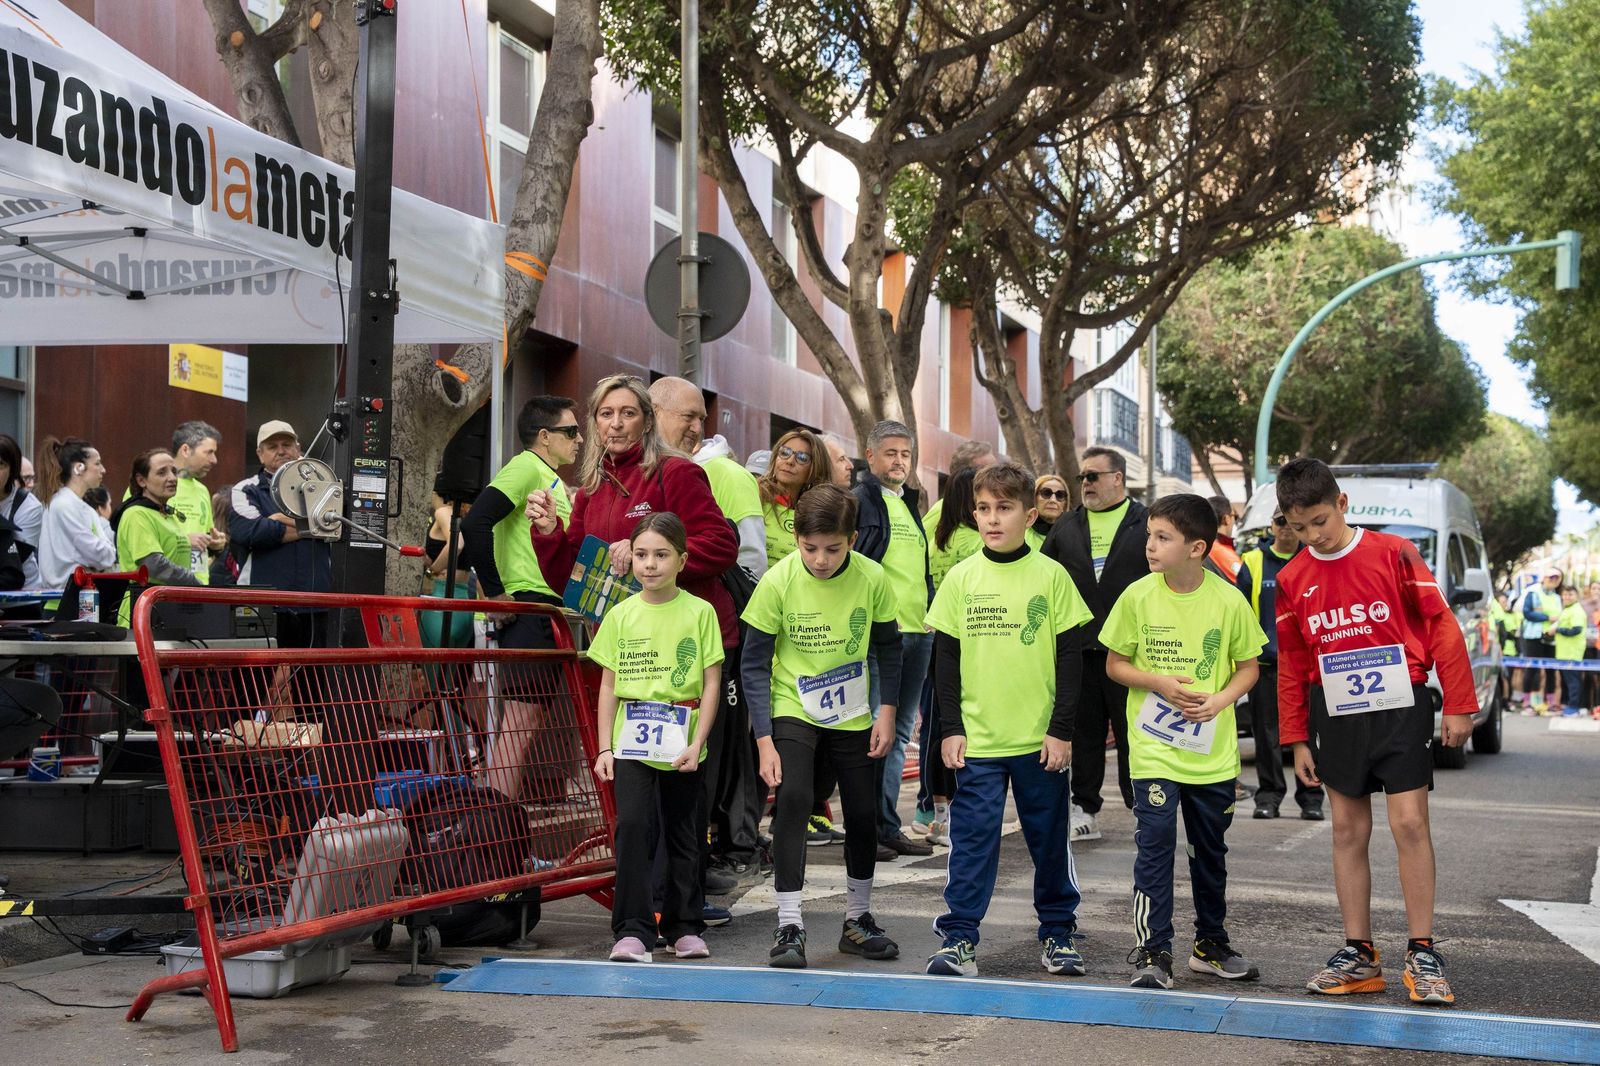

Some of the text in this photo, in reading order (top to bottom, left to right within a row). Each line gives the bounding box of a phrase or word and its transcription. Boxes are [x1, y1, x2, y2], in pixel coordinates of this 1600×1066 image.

[354, 458, 386, 467] FENIX
[973, 606, 1007, 614] Almería
[797, 624, 831, 633] Almería
[1320, 626, 1372, 643] RUNNING
[627, 650, 659, 659] Almería
[1332, 654, 1356, 663] Almería
[1367, 650, 1392, 658] marcha
[806, 681, 824, 689] contra
[831, 673, 850, 682] cáncer
[1346, 671, 1385, 696] 32
[820, 686, 845, 709] 41
[1154, 702, 1202, 736] 721
[635, 723, 664, 746] 31
